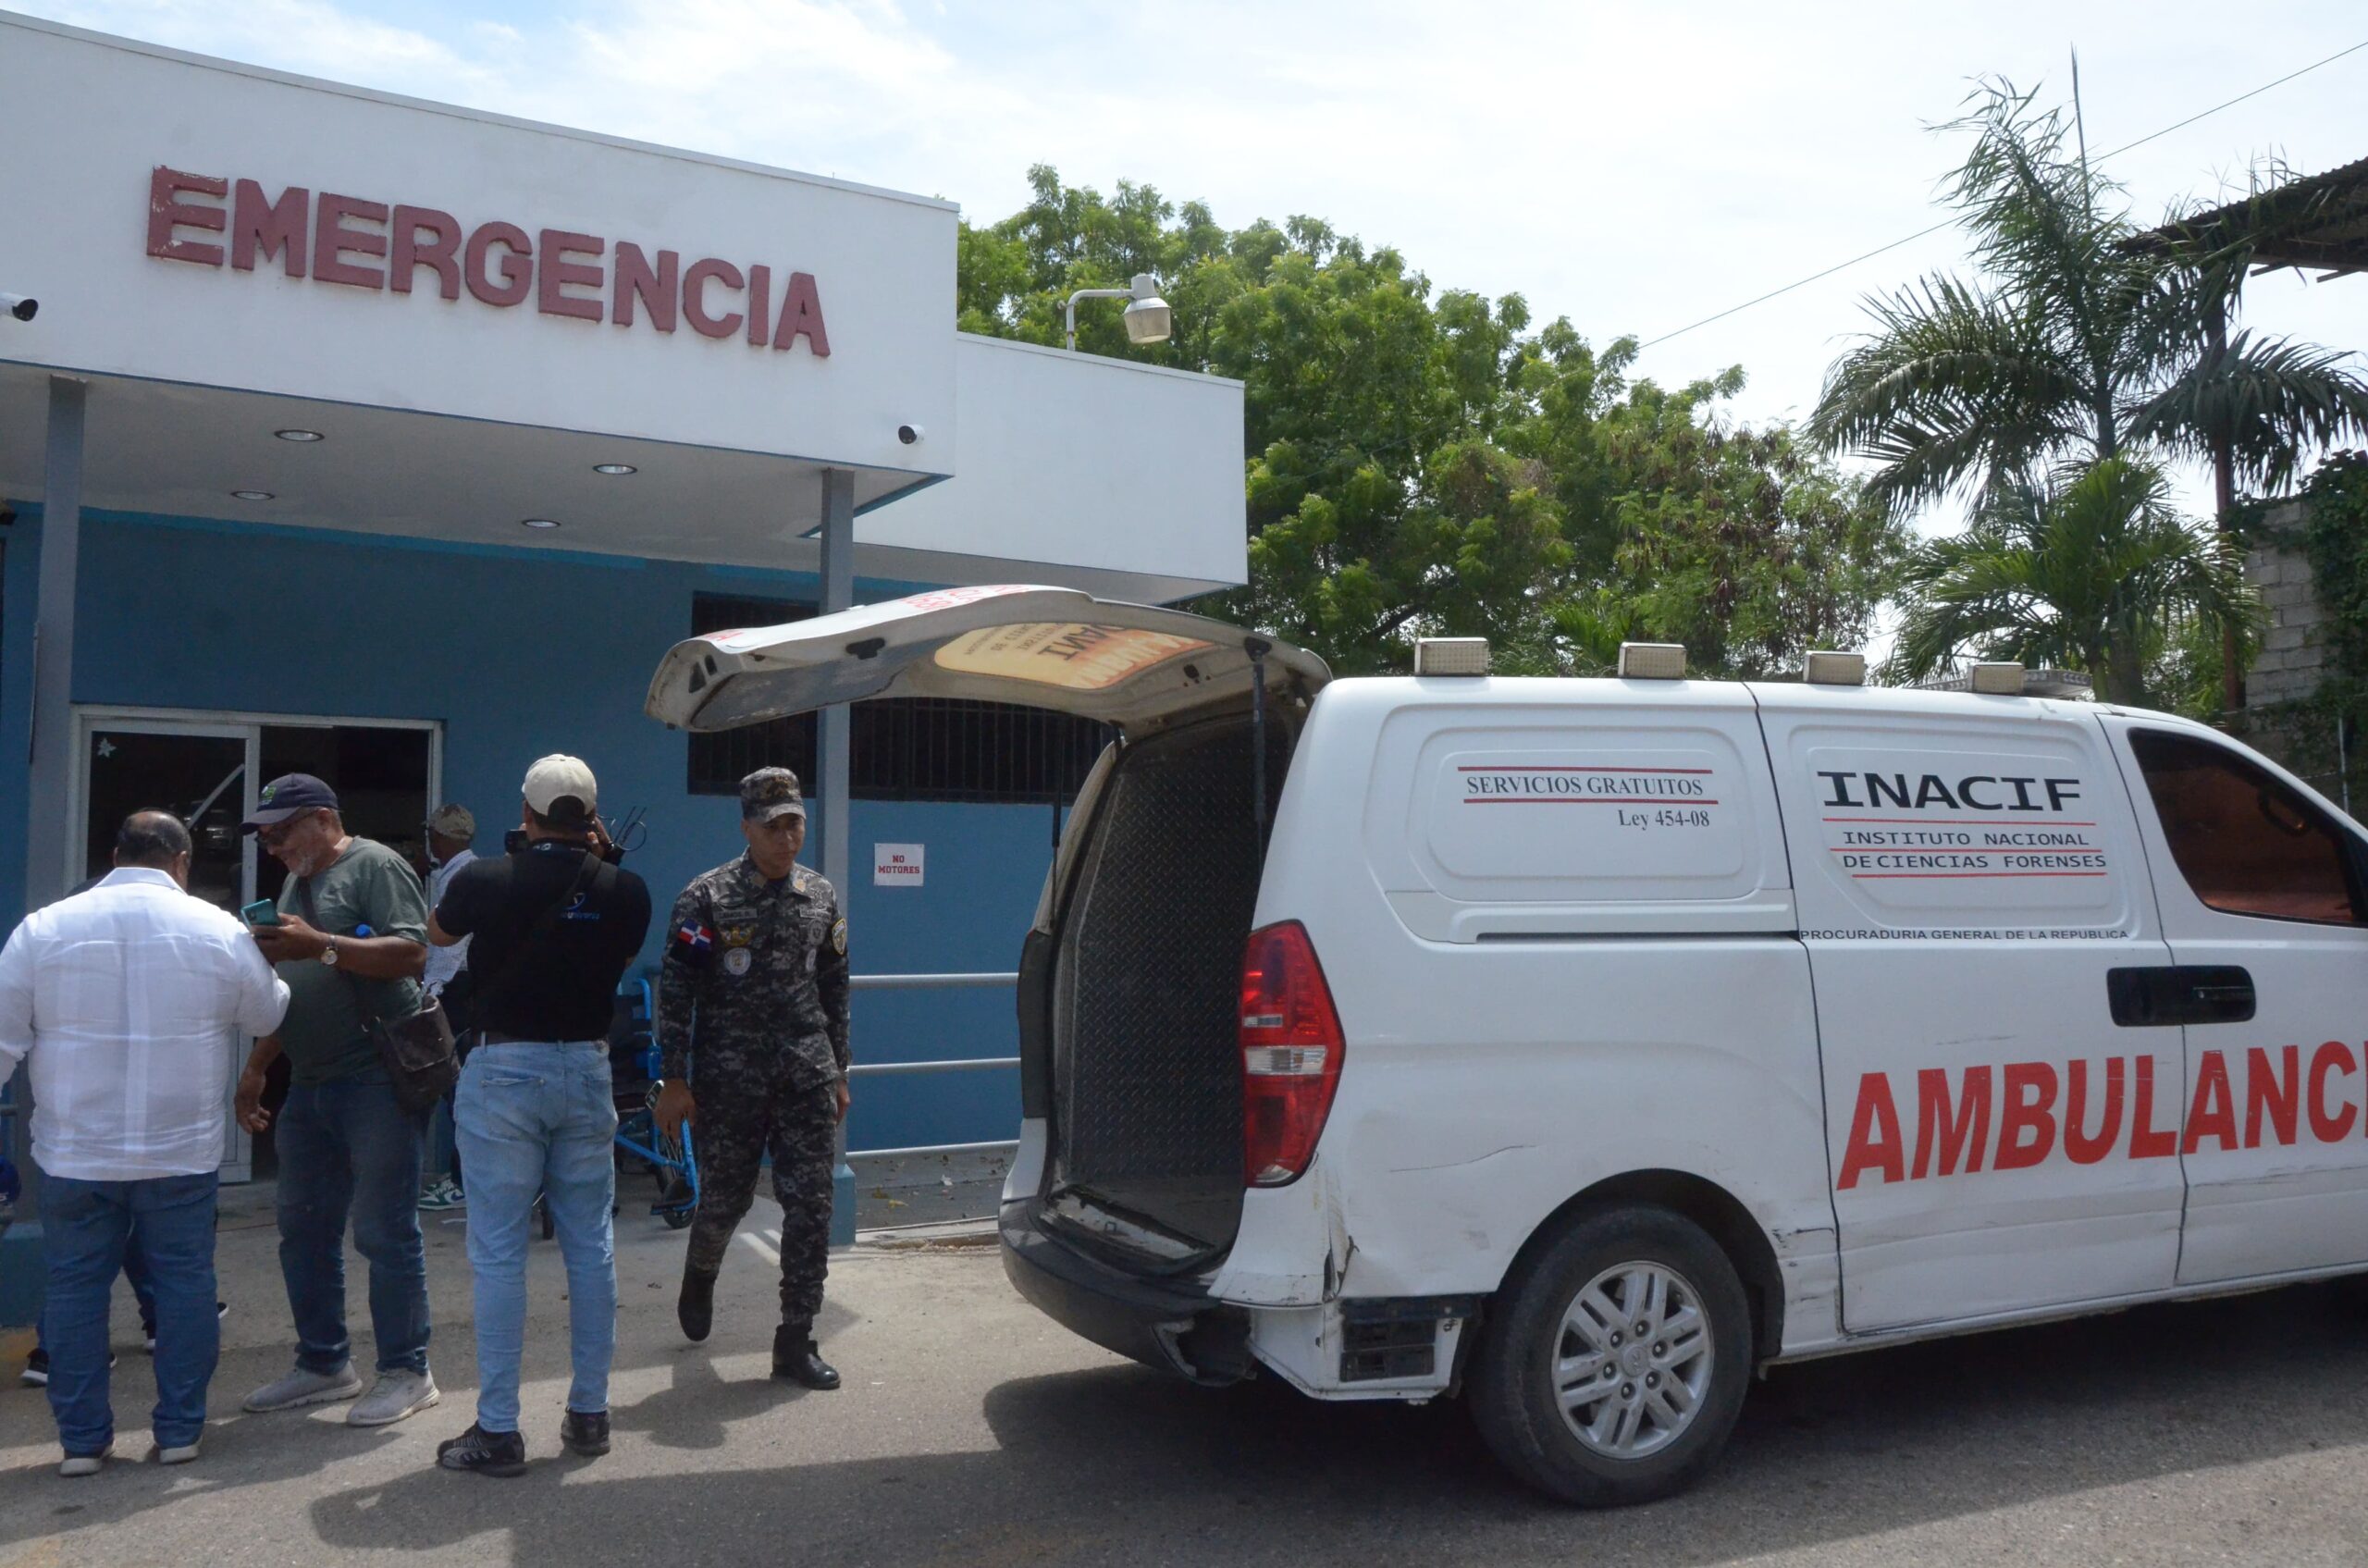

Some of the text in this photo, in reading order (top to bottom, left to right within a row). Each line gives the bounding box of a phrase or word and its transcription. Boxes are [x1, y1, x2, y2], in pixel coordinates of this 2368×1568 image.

[145, 165, 831, 358] EMERGENCIA
[1466, 776, 1704, 796] SERVICIOS GRATUITOS
[1816, 771, 2081, 811] INACIF
[1618, 809, 1710, 831] Ley 454-08
[1843, 832, 2090, 846] INSTITUTO NACIONAL
[892, 855, 905, 863] NO
[1843, 855, 2107, 869] DE CIENCIAS FORENSES
[878, 865, 920, 874] MOTORES
[1800, 929, 2129, 941] PROCURADURIA GENERAL DE LA REPUBLICA
[1836, 1040, 2368, 1191] AMBULANC
